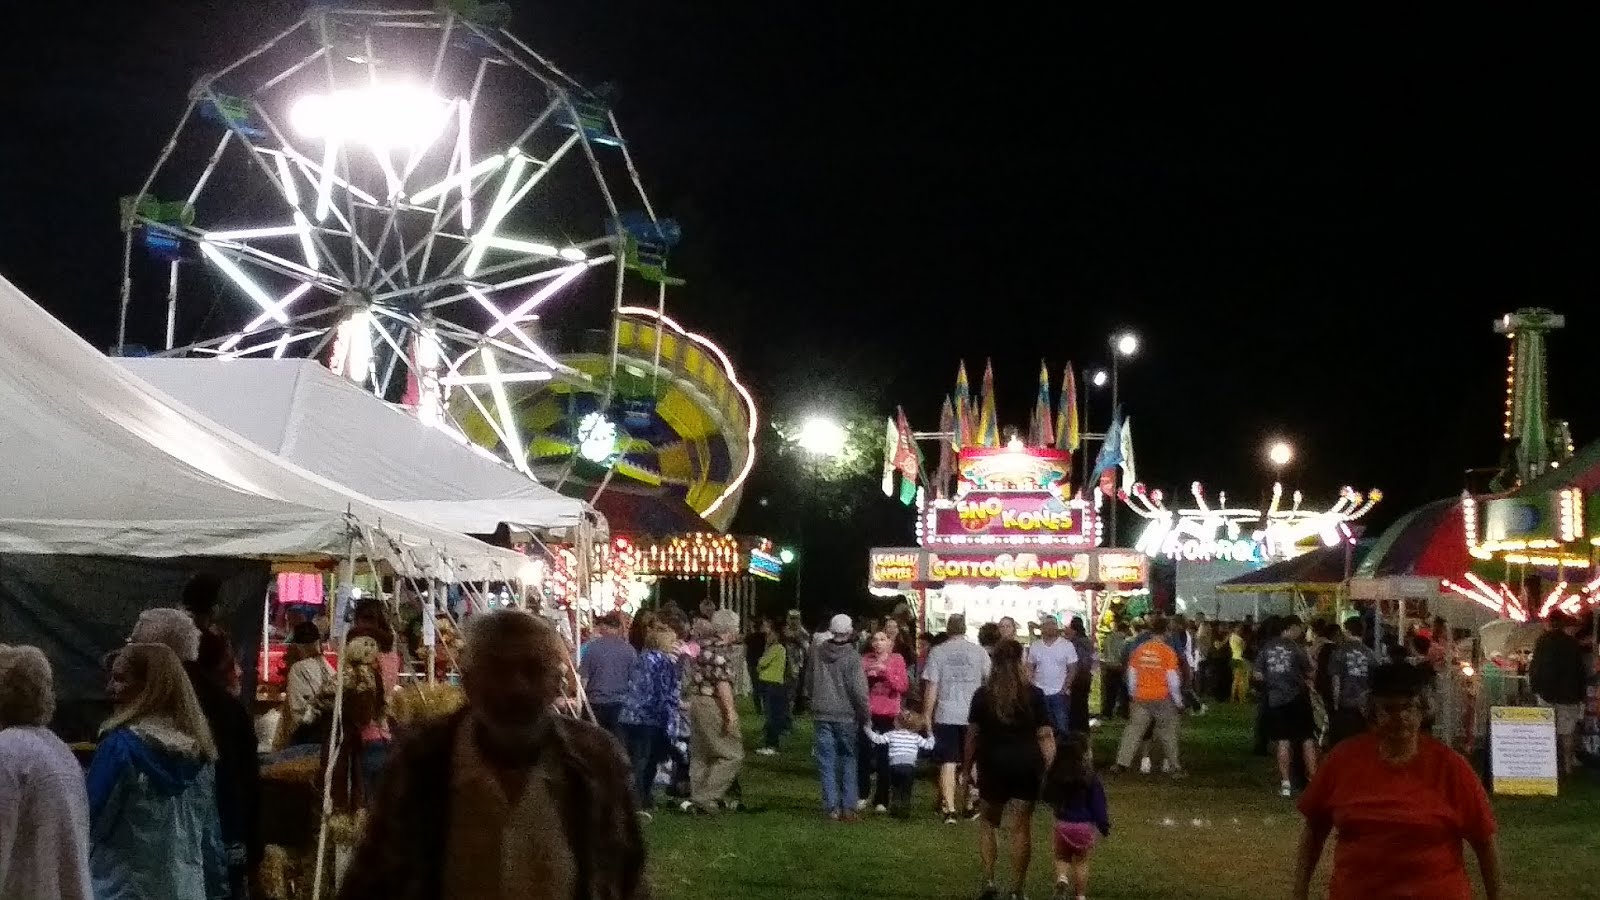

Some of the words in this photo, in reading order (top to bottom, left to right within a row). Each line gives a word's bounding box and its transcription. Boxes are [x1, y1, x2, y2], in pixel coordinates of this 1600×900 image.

[957, 497, 1002, 520] SNO
[1001, 509, 1073, 531] KONES
[932, 559, 1010, 578] COTTON
[1013, 559, 1083, 579] CANDY
